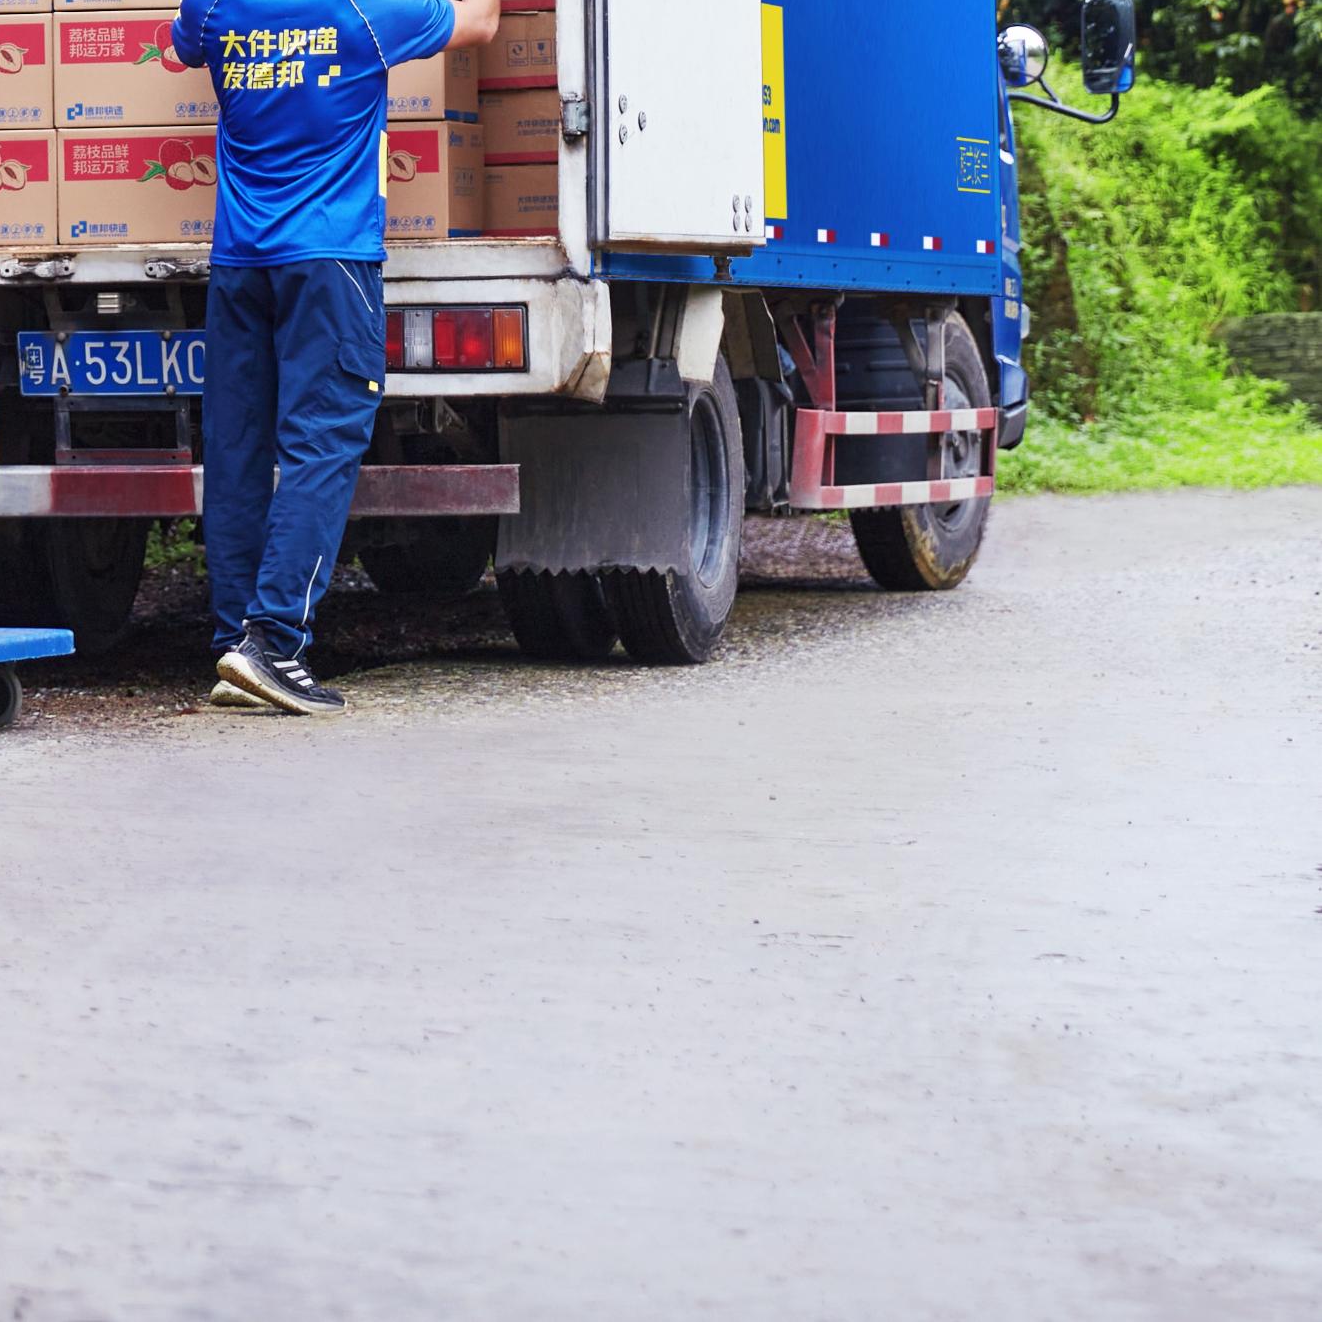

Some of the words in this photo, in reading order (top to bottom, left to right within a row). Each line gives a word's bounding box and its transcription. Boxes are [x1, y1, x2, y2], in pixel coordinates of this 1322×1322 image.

[70, 28, 124, 42] 荔枝品鲜
[219, 27, 338, 58] 大件快递
[70, 42, 124, 57] 邦运万家
[223, 60, 305, 89] 发德邦
[74, 144, 128, 159] 荔枝品鲜
[73, 160, 128, 174] 邦运万家
